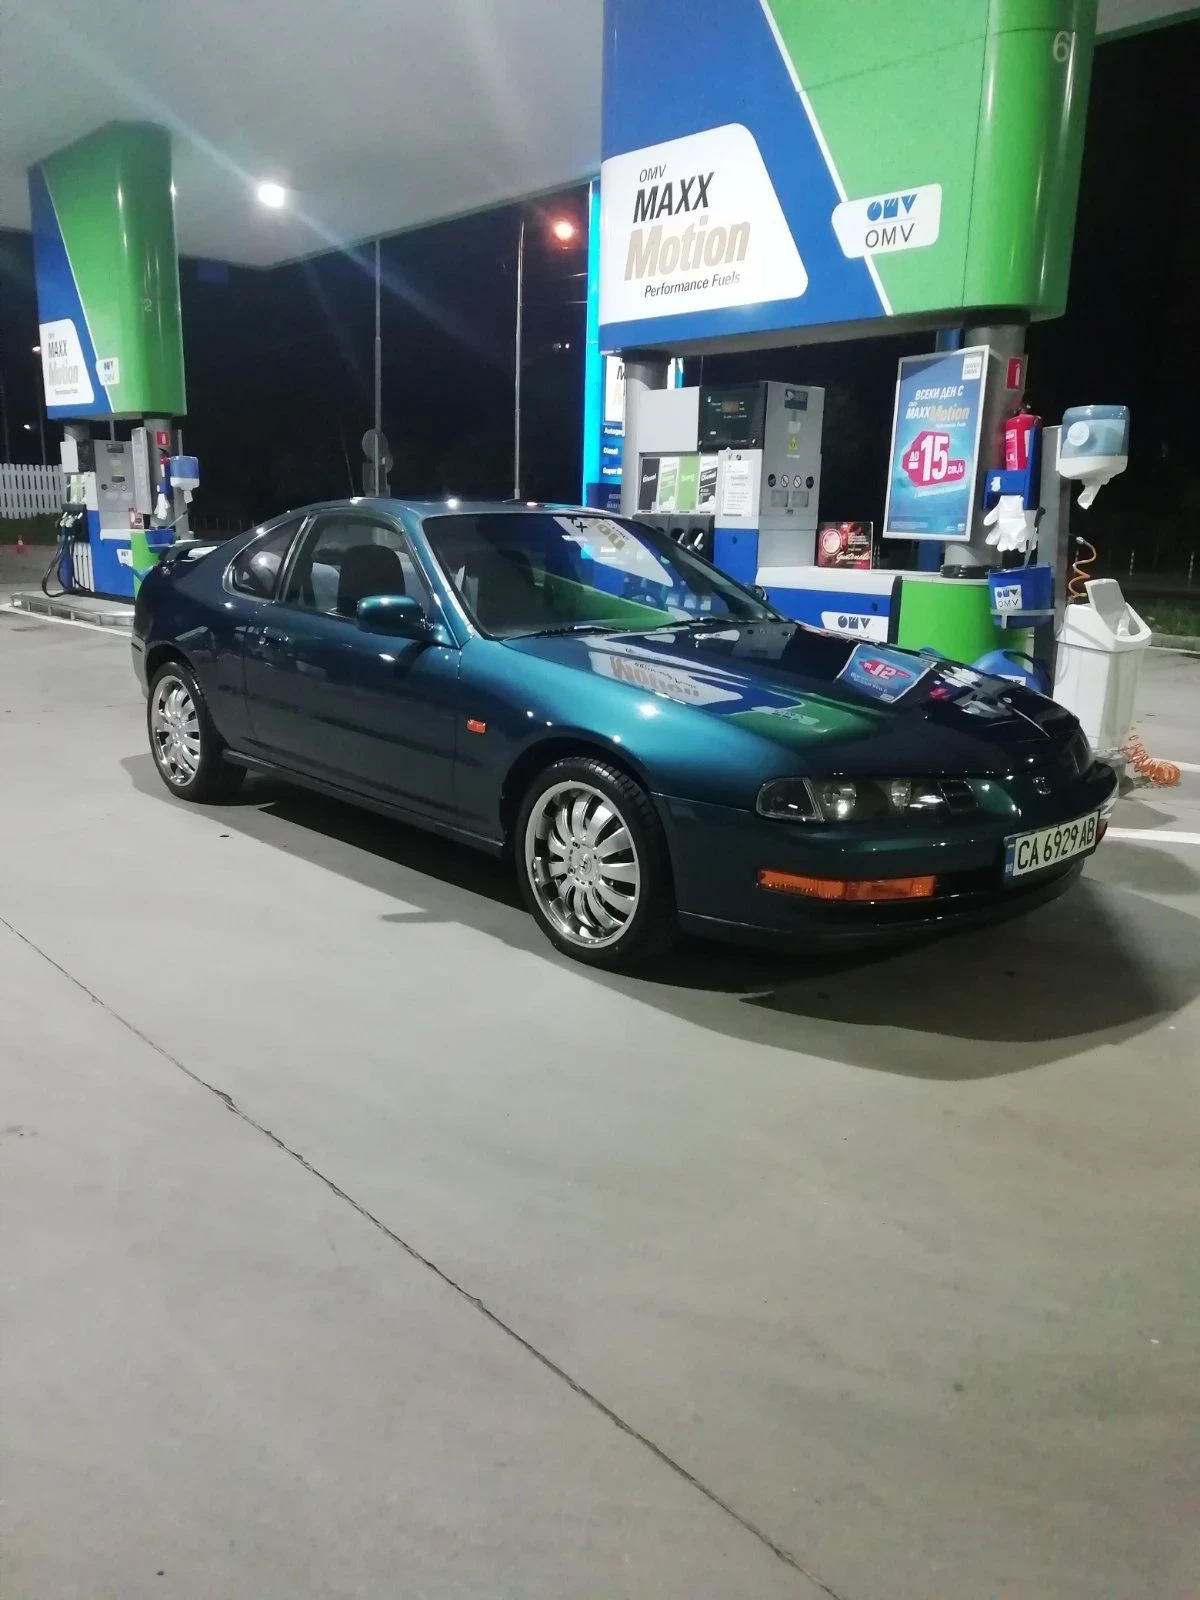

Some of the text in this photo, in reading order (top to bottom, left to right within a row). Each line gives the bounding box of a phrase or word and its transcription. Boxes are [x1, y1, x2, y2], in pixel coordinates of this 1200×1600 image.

[1053, 30, 1071, 62] 6
[639, 163, 667, 182] OMV
[633, 171, 715, 224] MAXX
[866, 193, 918, 222] OMV
[624, 214, 751, 281] Motion
[865, 222, 915, 248] OMV
[644, 270, 741, 298] Performance Fuels
[143, 298, 153, 312] 2
[48, 340, 68, 359] MAXX
[48, 358, 79, 386] Motion
[915, 388, 941, 401] ВСЕКИ
[940, 385, 958, 400] ДЕН
[920, 435, 949, 482] 15
[998, 599, 1018, 607] OMV
[838, 616, 870, 629] OMV
[1017, 817, 1095, 870] CA 6929 AB
